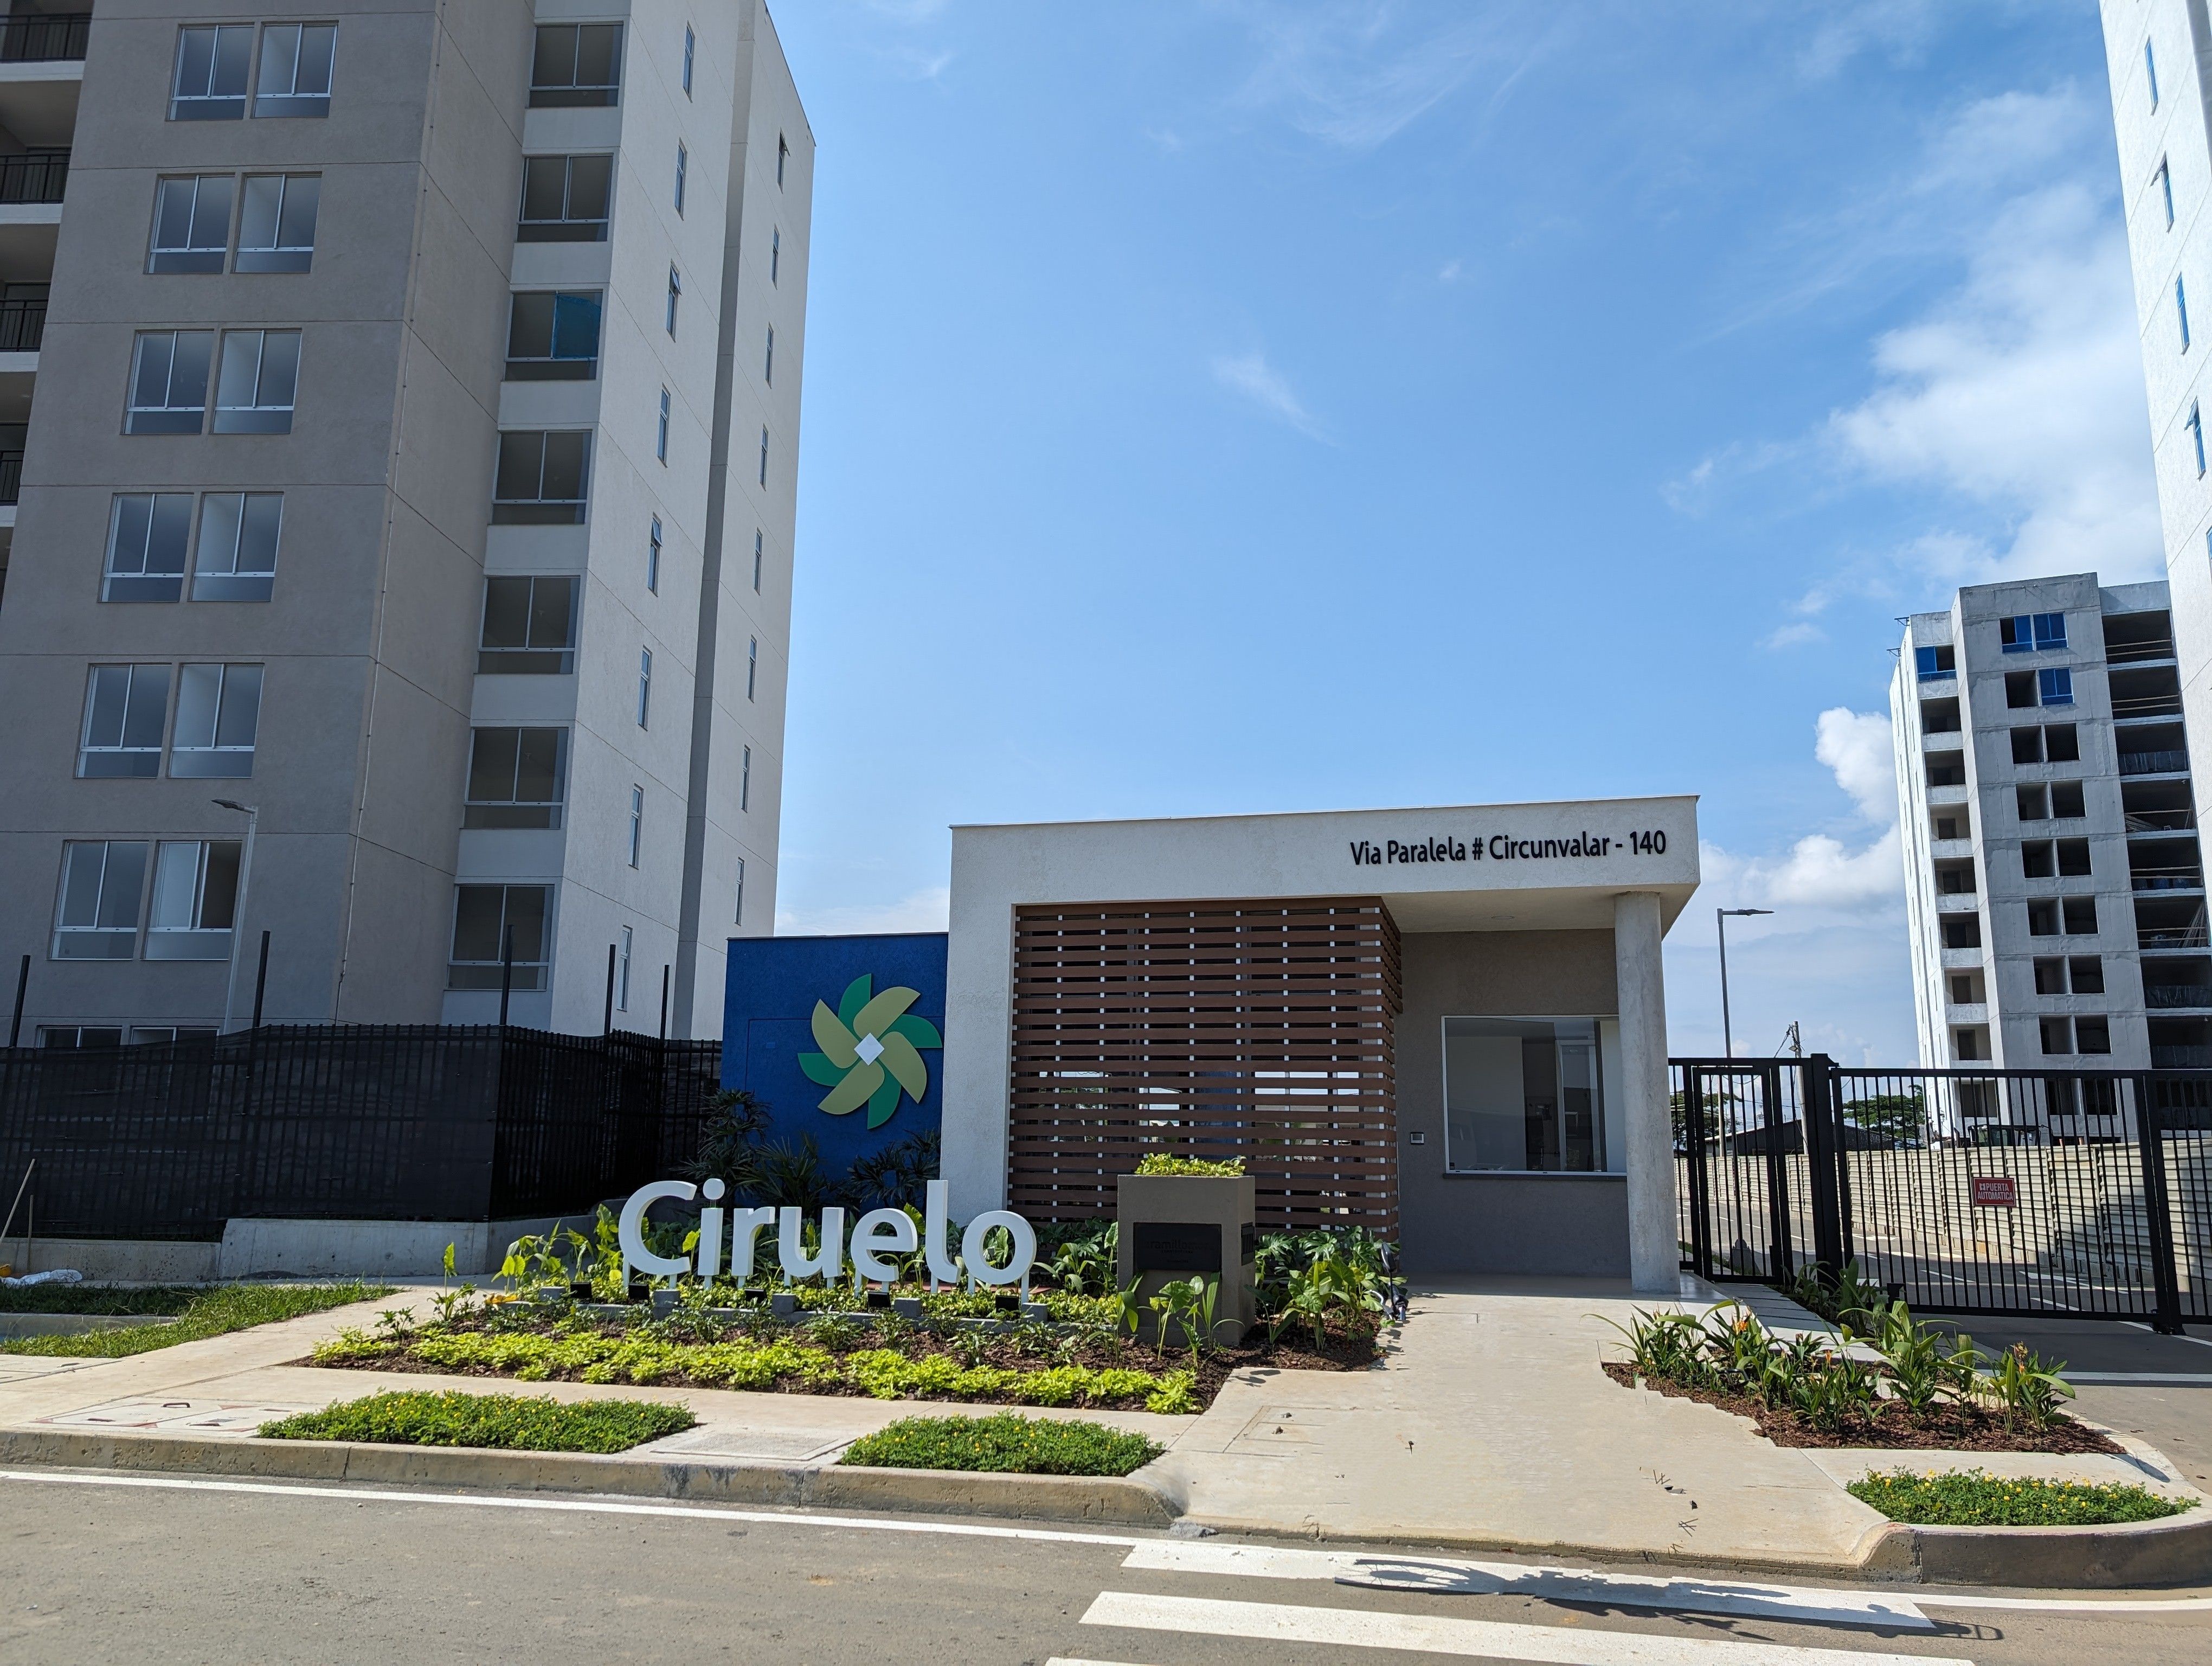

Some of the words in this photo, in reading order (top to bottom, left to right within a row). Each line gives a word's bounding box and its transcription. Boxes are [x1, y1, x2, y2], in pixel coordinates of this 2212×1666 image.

[1350, 841, 1381, 866] Via
[1387, 836, 1466, 864] Paralela
[1472, 837, 1483, 861] #
[1489, 831, 1610, 860] Circunvalar
[1629, 830, 1666, 855] 140
[1978, 1191, 2013, 1200] AUTOMATICA
[1986, 1183, 2009, 1191] PUERTA
[618, 1178, 1037, 1284] Ciruelo
